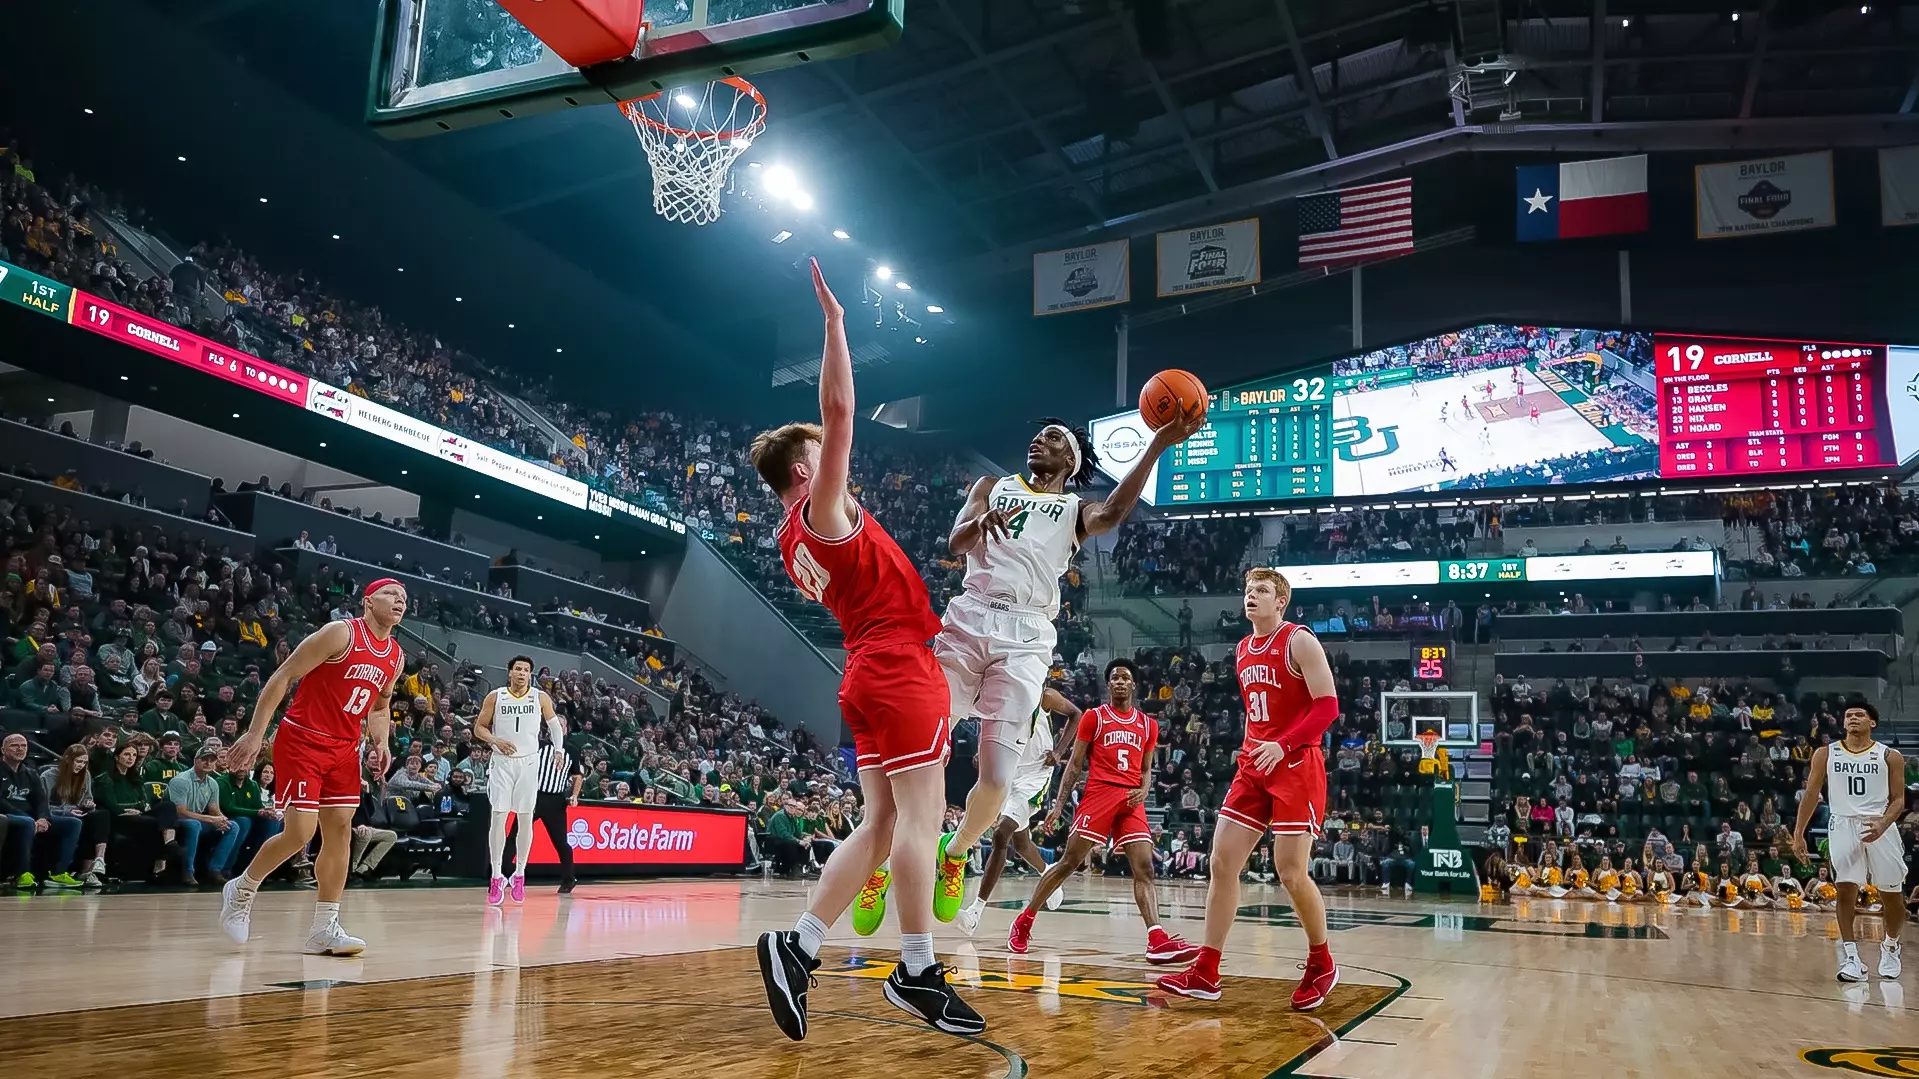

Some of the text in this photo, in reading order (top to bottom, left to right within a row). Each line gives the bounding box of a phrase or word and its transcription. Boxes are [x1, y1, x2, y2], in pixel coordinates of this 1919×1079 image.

[1740, 161, 1786, 176] BAYLOR
[1740, 193, 1790, 205] FINAL FOUR
[1734, 222, 1770, 232] NATIONAL
[1770, 217, 1815, 228] CHAMPIONS
[1190, 227, 1224, 242] BAYLOR
[1064, 248, 1098, 262] BAYLOR
[1200, 250, 1225, 261] FINAL
[1189, 259, 1226, 271] FOUR
[31, 280, 57, 299] 1ST
[1184, 281, 1211, 290] NATIONAL
[1212, 276, 1245, 286] CHAMPIONS
[22, 292, 60, 313] HALF
[89, 305, 110, 326] 19
[127, 323, 181, 352] CORNELL
[208, 352, 256, 378] FLS 6 TO
[1667, 344, 1705, 372] 19
[1713, 351, 1774, 365] CORNELL
[1807, 354, 1813, 362] 6
[1687, 374, 1710, 382] FLOOR
[1766, 368, 1780, 376] PTS
[1292, 377, 1326, 402] 32
[1673, 372, 1861, 395] 5 BECCLES 0 0 0 0
[1240, 389, 1286, 405] BAYLOR
[1672, 383, 1862, 404] 13 GRAY 2 0 0 2
[1290, 405, 1301, 413] AST
[1672, 406, 1683, 414] 20
[1688, 403, 1727, 413] HANSEN
[1799, 397, 1806, 406] 0
[1672, 405, 1834, 424] 23 NIX 3 0 0
[358, 409, 430, 442] HELBERG BARBECUE
[1672, 414, 1864, 434] 31 NOARD 0 0 0 0
[1101, 440, 1147, 450] NISSAN
[1187, 440, 1215, 449] DENNIS
[1675, 442, 1690, 450] AST
[1706, 441, 1713, 449] 3
[1747, 438, 1762, 446] STL
[1779, 437, 1785, 445] 2
[1174, 448, 1219, 458] 11 BRIDGES
[1187, 457, 1208, 466] MISSI
[1293, 451, 1299, 460] 0
[1748, 449, 1764, 457] BLK
[1676, 463, 1697, 471] DREB
[1707, 462, 1713, 471] 3
[1748, 460, 1759, 468] TO
[1857, 454, 1864, 463] 3
[1232, 470, 1244, 478] STL
[997, 496, 1065, 523] BAYLOR
[1448, 561, 1490, 581] 8:37
[1501, 562, 1518, 572] 1ST
[1498, 570, 1522, 580] HALF
[990, 601, 1010, 612] BEARS
[1421, 647, 1446, 659] 8:37
[1418, 658, 1444, 679] 25
[344, 663, 388, 693] CORNELL
[342, 686, 372, 716] 13
[1249, 691, 1270, 722] 31
[501, 705, 535, 715] BAYLOR
[515, 716, 520, 733] 1
[1103, 730, 1142, 751] CORNELL
[1117, 748, 1128, 772] 5
[1833, 761, 1879, 775] BAYLOR
[298, 781, 307, 798] C
[1847, 775, 1866, 796] 10
[1082, 814, 1091, 828] C
[1428, 848, 1463, 869] TNB
[1420, 869, 1471, 879] Your Bank for Life
